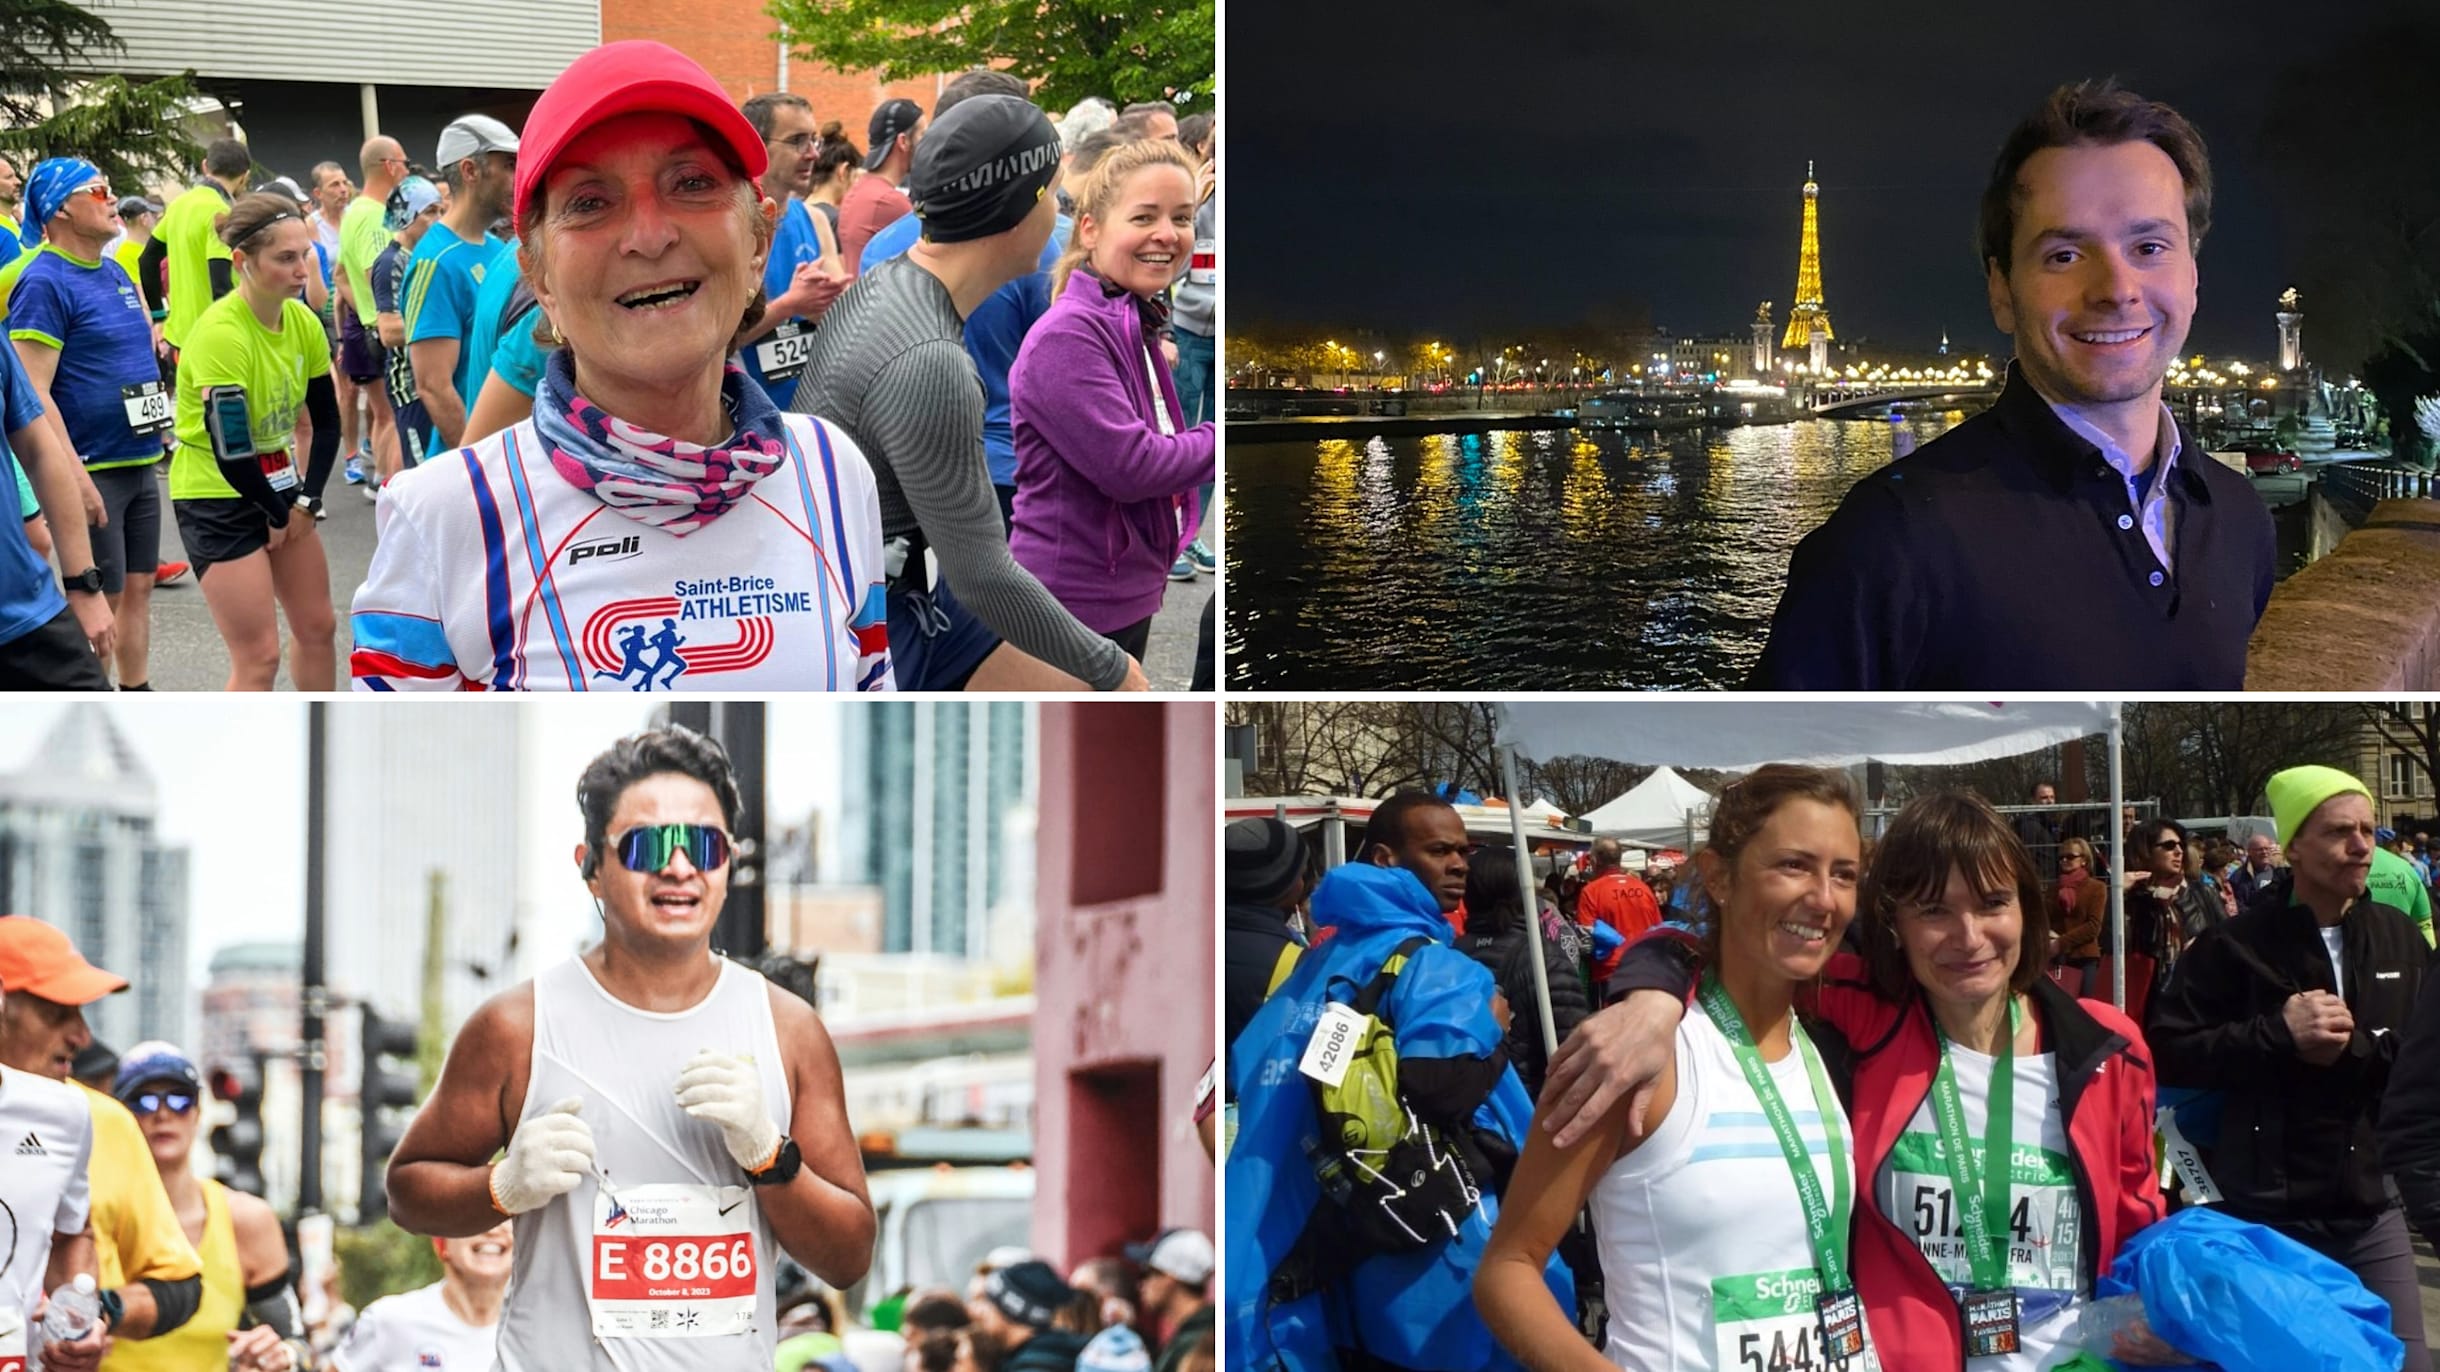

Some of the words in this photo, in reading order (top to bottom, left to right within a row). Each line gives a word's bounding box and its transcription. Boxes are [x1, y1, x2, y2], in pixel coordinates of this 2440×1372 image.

[774, 337, 810, 365] 524
[142, 396, 164, 420] 489
[568, 535, 641, 566] poli
[674, 575, 775, 597] Saint-Brice
[681, 592, 812, 621] ATHLETISME
[1319, 1021, 1350, 1073] 42086
[1748, 1056, 1766, 1082] PARIS
[1763, 1081, 1775, 1100] DE
[1941, 1081, 1959, 1136] MARATHON
[1771, 1100, 1801, 1158] MARATHON
[1953, 1138, 1963, 1152] DE
[1955, 1153, 1970, 1183] PARIS
[630, 1206, 668, 1216] Chicago
[1798, 1171, 1824, 1240] Schneider
[1914, 1186, 2031, 1242] 514
[630, 1217, 677, 1225] Marathon
[1968, 1195, 1990, 1262] Schneider
[2057, 1222, 2075, 1245] 15
[600, 1242, 627, 1280] E
[643, 1240, 751, 1281] 8866
[2010, 1247, 2033, 1264] FRA
[648, 1288, 680, 1296] October
[691, 1288, 711, 1296] 2023
[1755, 1274, 1823, 1299] Schnei
[1969, 1307, 2011, 1325] PARIS
